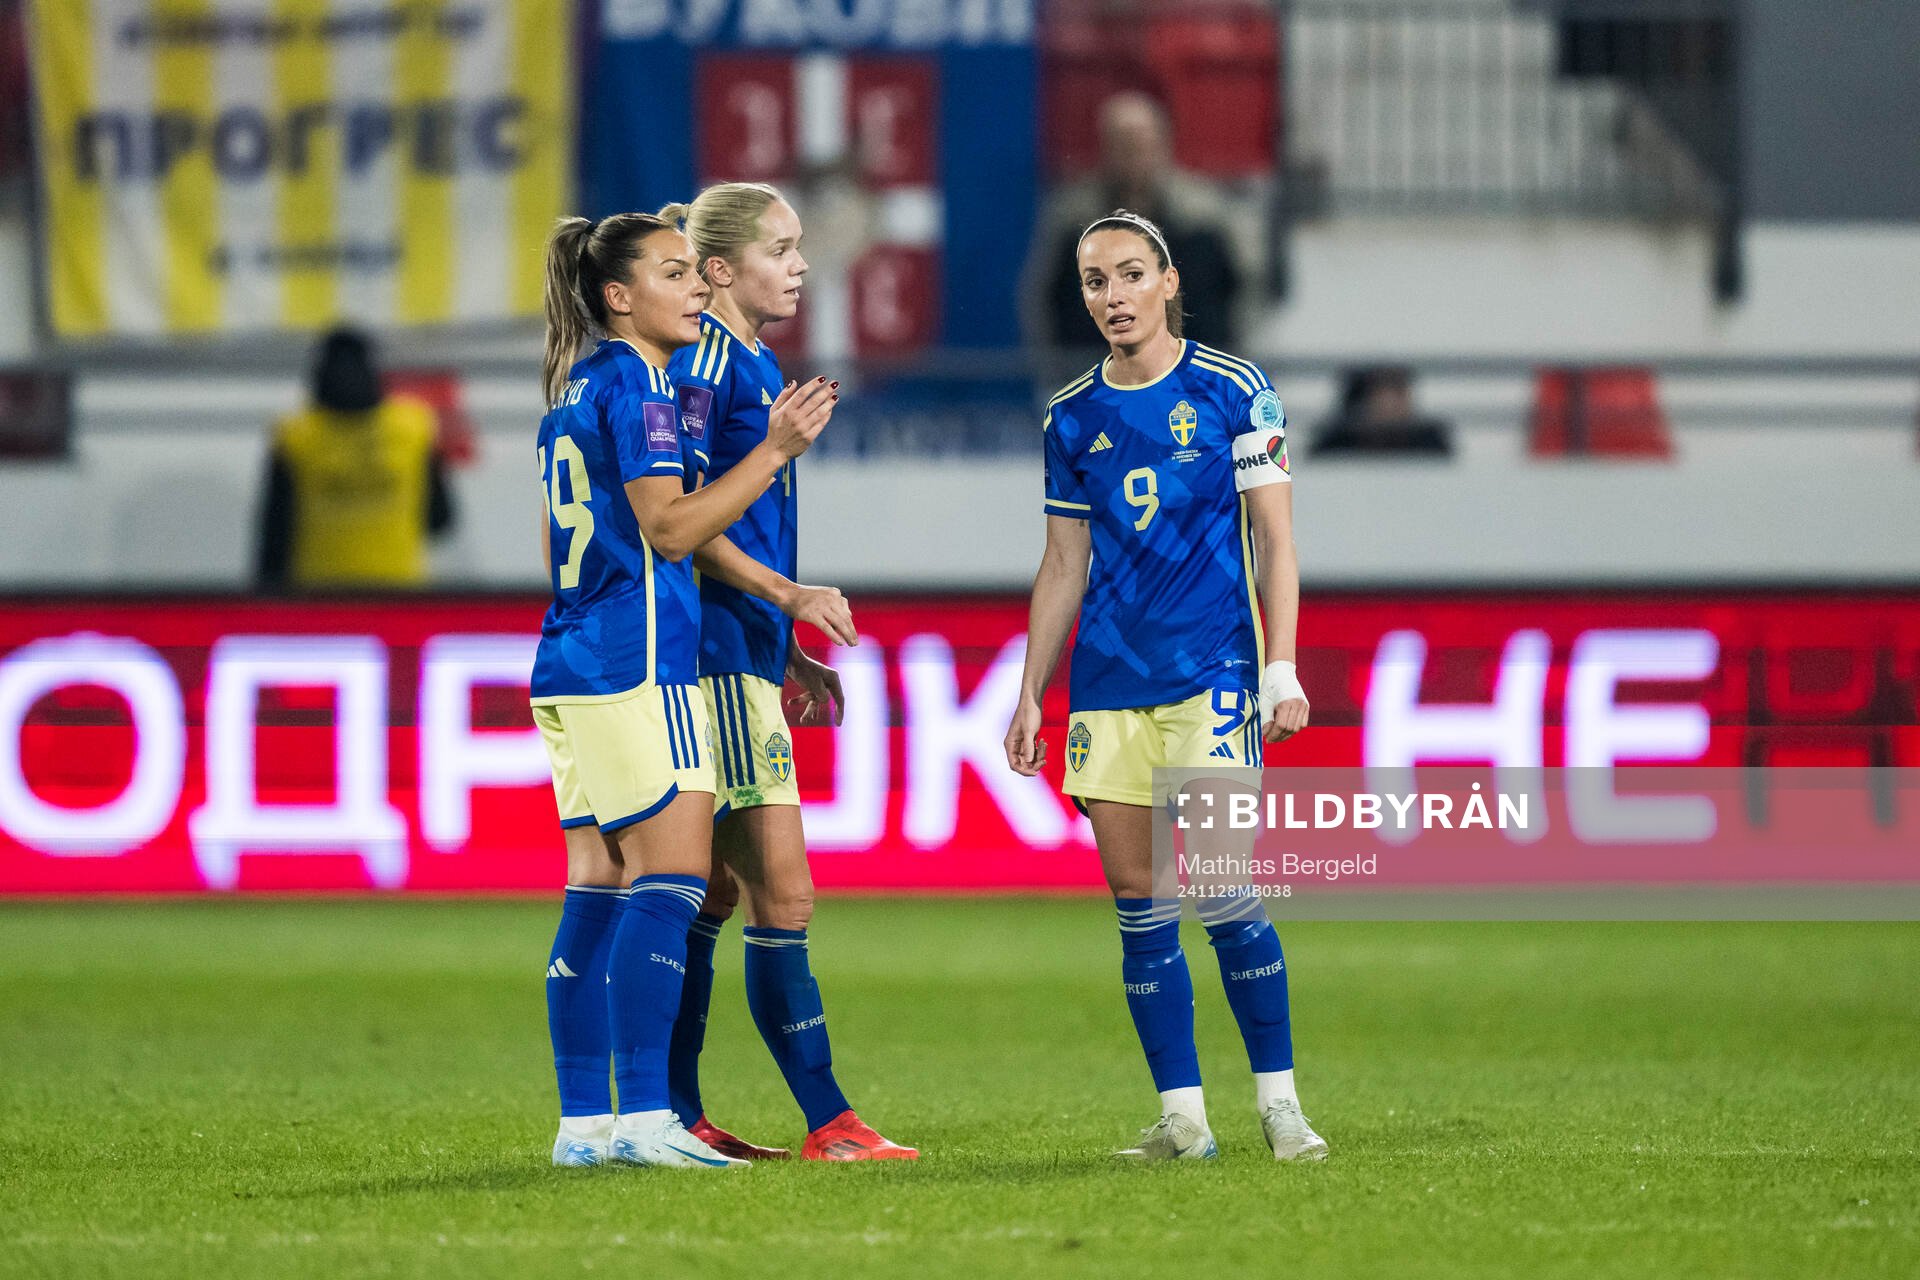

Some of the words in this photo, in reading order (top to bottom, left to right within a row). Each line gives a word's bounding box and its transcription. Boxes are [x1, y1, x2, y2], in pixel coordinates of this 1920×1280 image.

[74, 97, 528, 185] ПРОГРЕС
[1123, 466, 1160, 532] 9
[1211, 687, 1246, 737] 9
